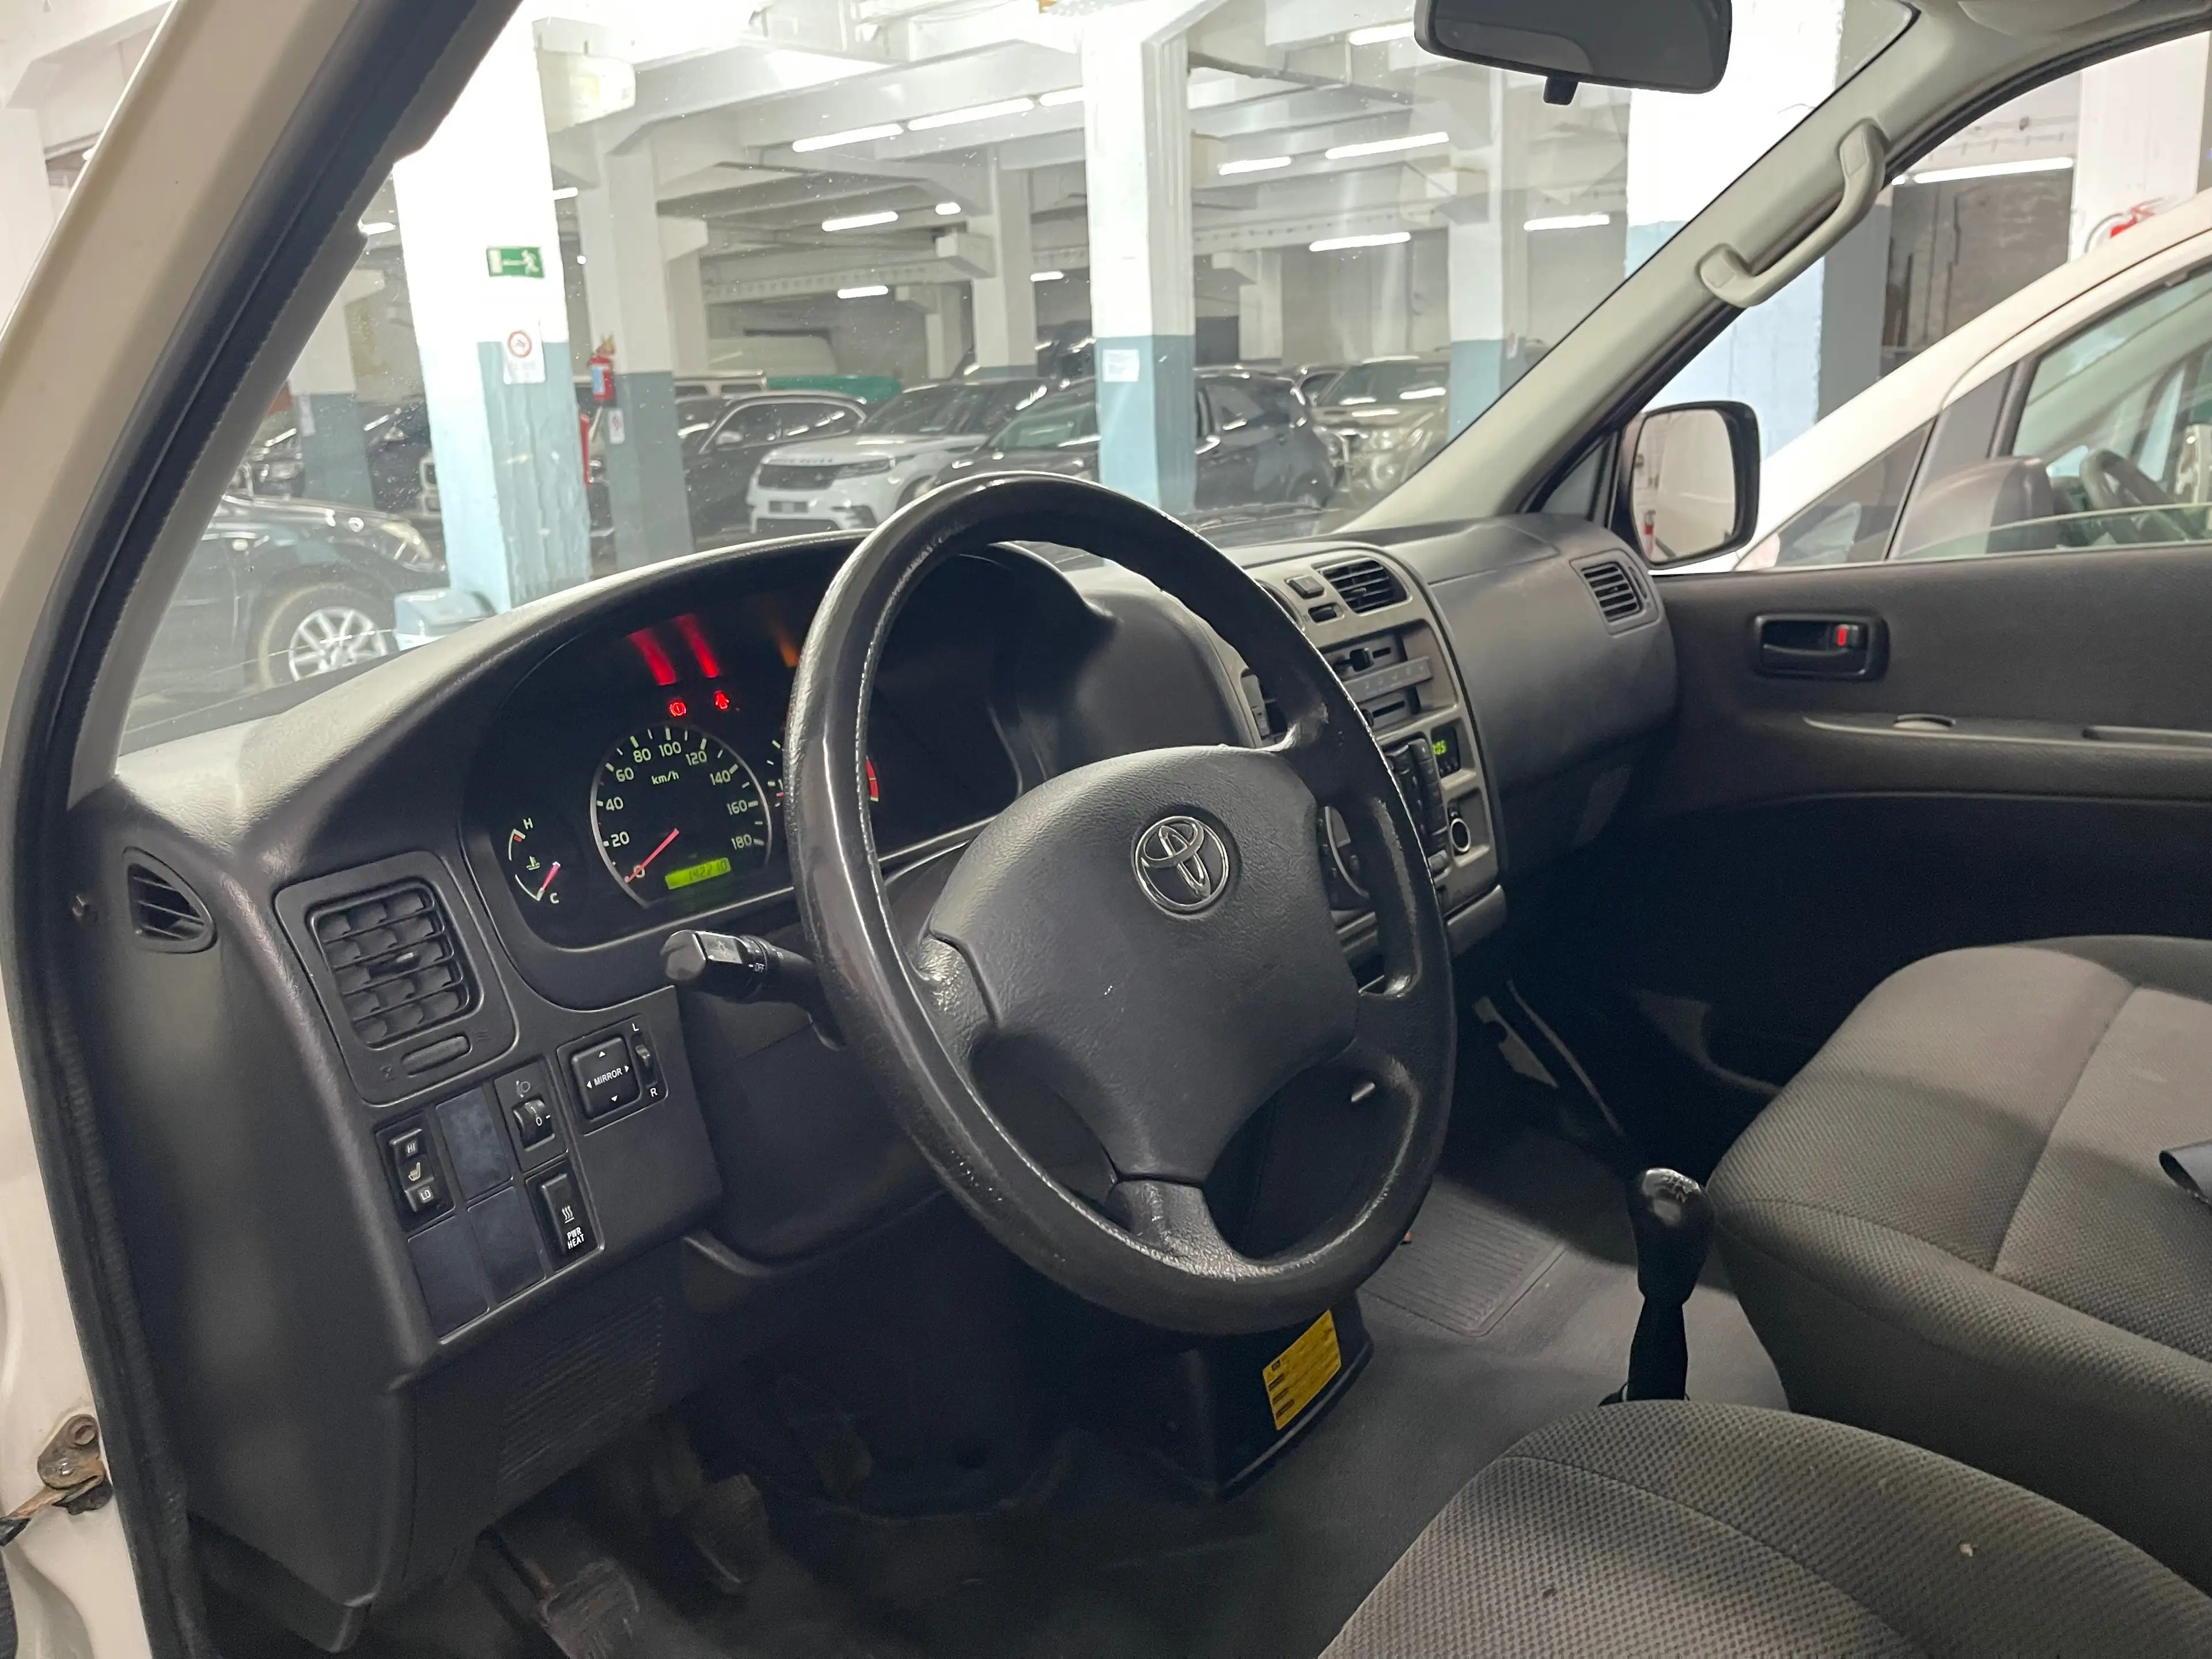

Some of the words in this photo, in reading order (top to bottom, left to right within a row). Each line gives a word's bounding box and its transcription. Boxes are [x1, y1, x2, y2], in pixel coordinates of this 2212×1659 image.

[633, 748, 652, 763] 80
[659, 741, 682, 757] 100
[685, 750, 707, 766] 120
[615, 767, 634, 782] 60
[652, 771, 680, 786] km/h
[710, 770, 732, 786] 140
[605, 796, 624, 812] 40
[726, 799, 748, 815] 160
[523, 817, 533, 830] H
[611, 831, 630, 847] 20
[730, 834, 752, 850] 180
[550, 892, 559, 904] C
[632, 1022, 639, 1032] L
[593, 1067, 623, 1086] MIRROR
[650, 1087, 658, 1097] R
[407, 1142, 416, 1153] HI
[420, 1189, 431, 1200] LO
[567, 1226, 582, 1241] PWR
[567, 1233, 584, 1250] HEAT
